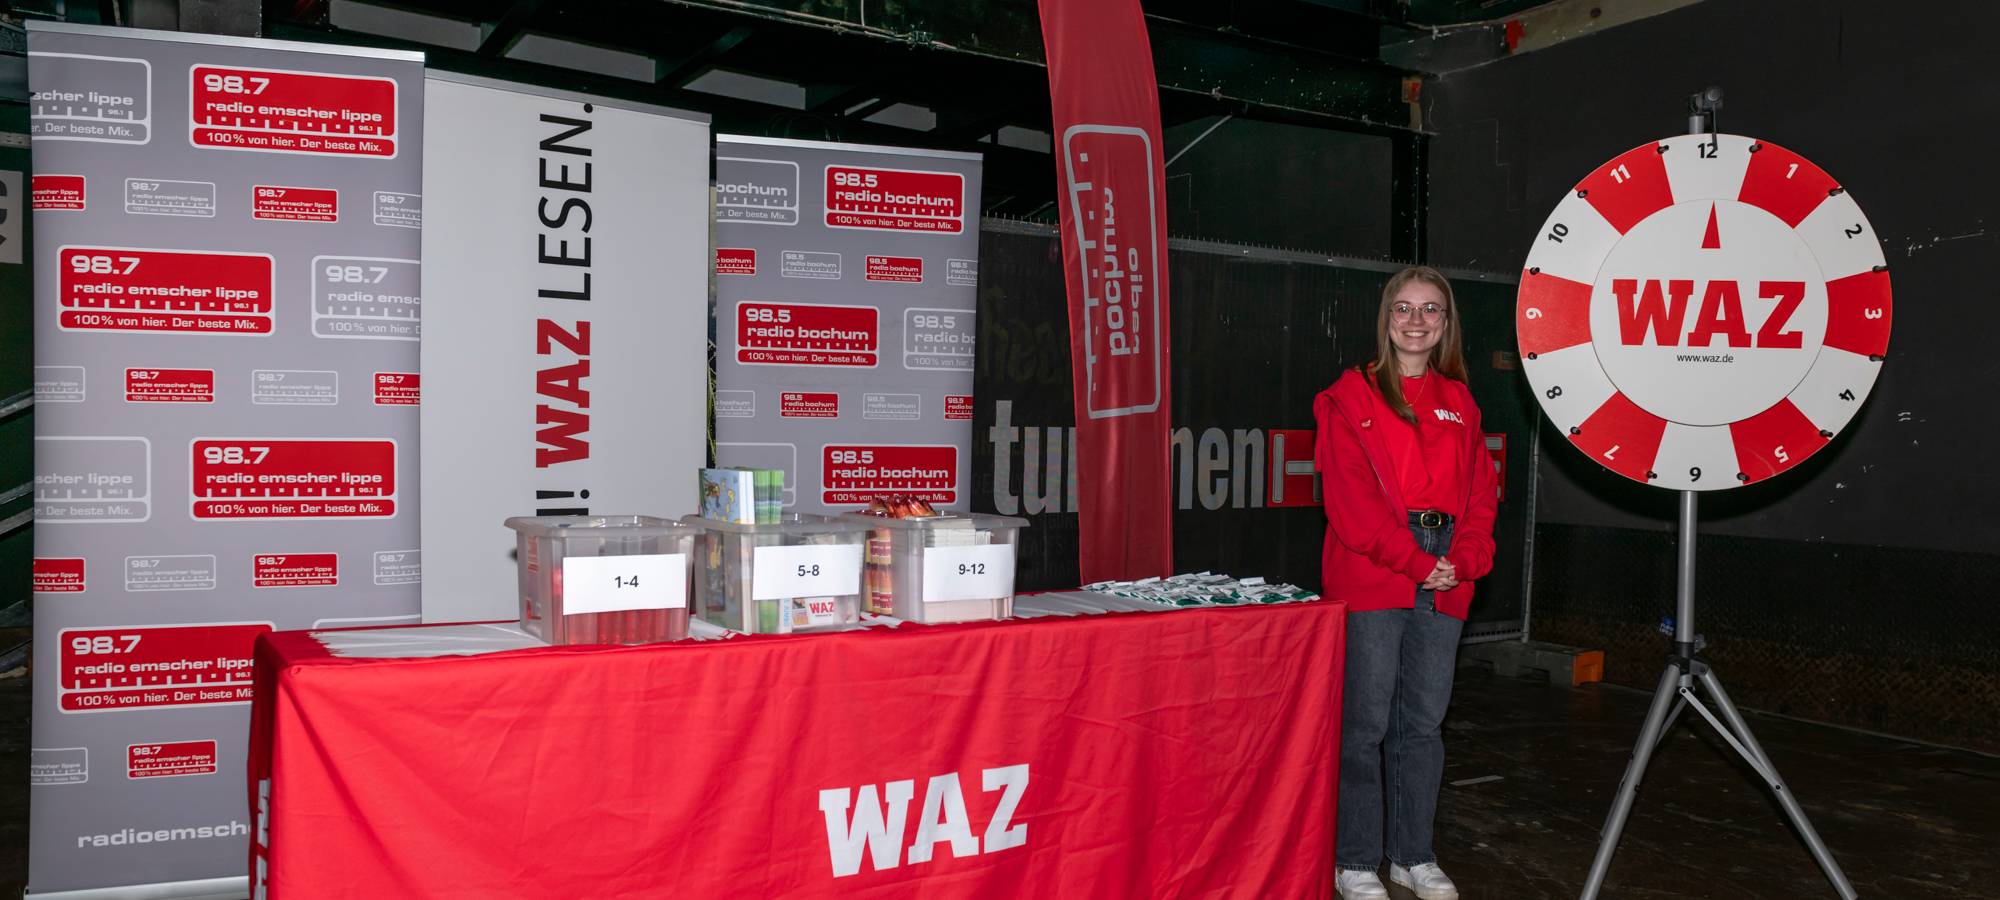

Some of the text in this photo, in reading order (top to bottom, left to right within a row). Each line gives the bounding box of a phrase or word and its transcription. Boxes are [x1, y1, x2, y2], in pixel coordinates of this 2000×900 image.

[204, 74, 269, 95] 98.7
[32, 90, 133, 106] scher lippe
[206, 100, 382, 123] radio emscher lippe
[46, 123, 133, 136] Der beste Mix.
[248, 136, 268, 145] von
[272, 137, 295, 146] hier.
[301, 138, 321, 148] Der
[325, 139, 355, 149] beste
[360, 141, 381, 151] Mix.
[1698, 142, 1717, 159] 12
[1610, 163, 1631, 184] 11
[1785, 163, 1799, 179] 1
[835, 172, 878, 187] 98.5
[538, 103, 592, 301] LESEN.
[836, 188, 954, 207] radio bochum
[746, 210, 768, 218] beste
[914, 221, 935, 229] beste
[938, 222, 953, 230] Mix.
[1548, 222, 1569, 244] 10
[1845, 223, 1863, 239] 2
[72, 255, 141, 275] 98.7
[326, 265, 388, 283] 98.7
[74, 282, 258, 300] radio emscher lippe
[328, 292, 420, 304] radio emsc
[747, 308, 791, 323] 98.5
[1612, 278, 1806, 349] WAZ
[1865, 308, 1882, 319] 3
[118, 317, 139, 326] von
[144, 317, 168, 326] hier.
[174, 318, 195, 327] Der
[199, 318, 231, 328] beste
[235, 319, 258, 328] Mix.
[914, 315, 955, 328] 98.5
[748, 325, 869, 340] radio bochum
[915, 332, 958, 343] radio
[1677, 353, 1734, 364] www.waz.de
[536, 319, 590, 468] WAZ
[1546, 386, 1562, 399] 8
[1839, 388, 1856, 402] 4
[204, 447, 270, 464] 98.7
[831, 451, 873, 464] 98.5
[1603, 445, 1620, 460] 7
[1774, 446, 1790, 463] 5
[36, 473, 133, 486] scher lippe
[207, 473, 382, 484] radio emscher lippe
[832, 467, 948, 478] radio bochum
[46, 506, 65, 515] Der
[70, 506, 103, 515] beste
[108, 506, 133, 515] Mix.
[272, 505, 295, 513] hier.
[301, 505, 321, 513] Der
[325, 504, 356, 512] beste
[360, 504, 382, 512] Mix.
[798, 565, 820, 577] 5-8
[958, 563, 985, 575] 9-12
[615, 576, 639, 588] 1-4
[72, 635, 142, 655] 98.7
[75, 662, 126, 674] radio
[130, 659, 213, 672] emscher
[119, 695, 140, 703] von
[145, 693, 169, 702] hier.
[175, 691, 196, 700] Der
[200, 689, 232, 699] beste
[818, 763, 1029, 878] WAZ
[78, 820, 250, 848] radioemsch
